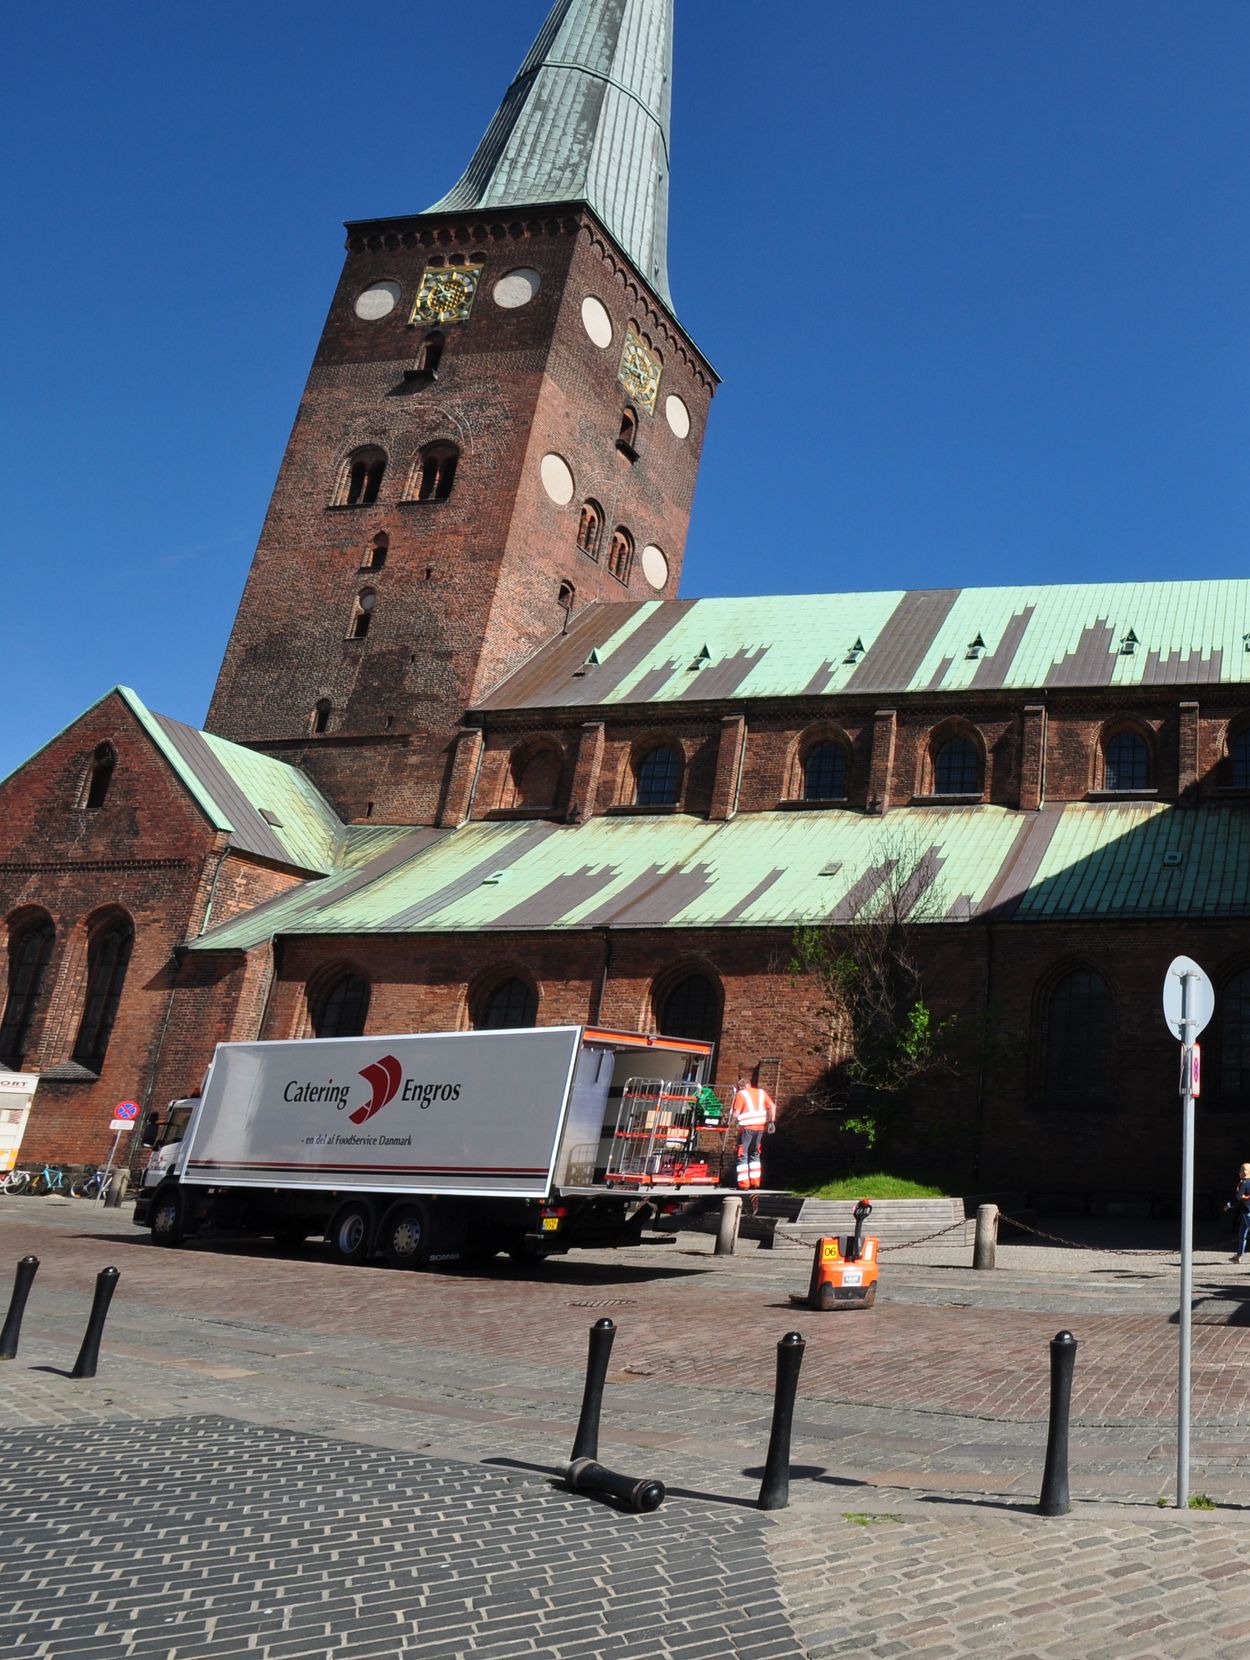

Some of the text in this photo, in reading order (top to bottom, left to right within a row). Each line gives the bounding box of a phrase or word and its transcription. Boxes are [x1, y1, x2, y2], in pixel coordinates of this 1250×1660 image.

[283, 1078, 462, 1110] Catering Engros
[305, 1137, 315, 1145] en
[335, 1135, 378, 1146] FoodService
[379, 1135, 412, 1146] Danmark
[824, 1246, 837, 1257] 06
